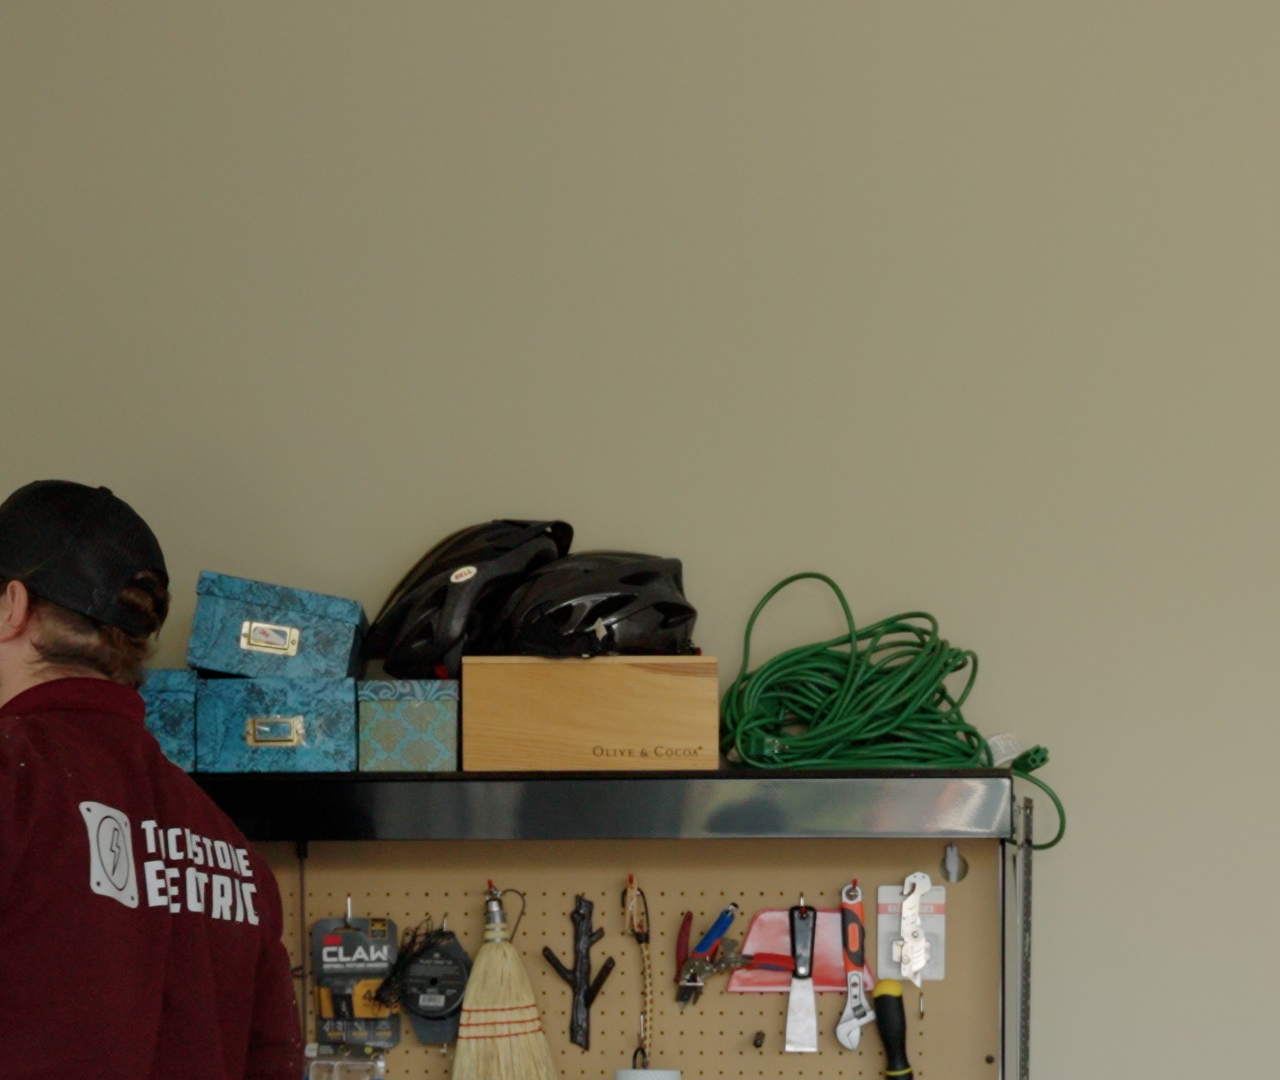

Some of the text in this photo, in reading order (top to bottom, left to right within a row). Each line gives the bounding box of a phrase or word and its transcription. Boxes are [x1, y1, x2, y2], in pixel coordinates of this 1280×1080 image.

[592, 745, 634, 758] OLIVE
[639, 748, 648, 758] &
[322, 944, 389, 963] CLAW
